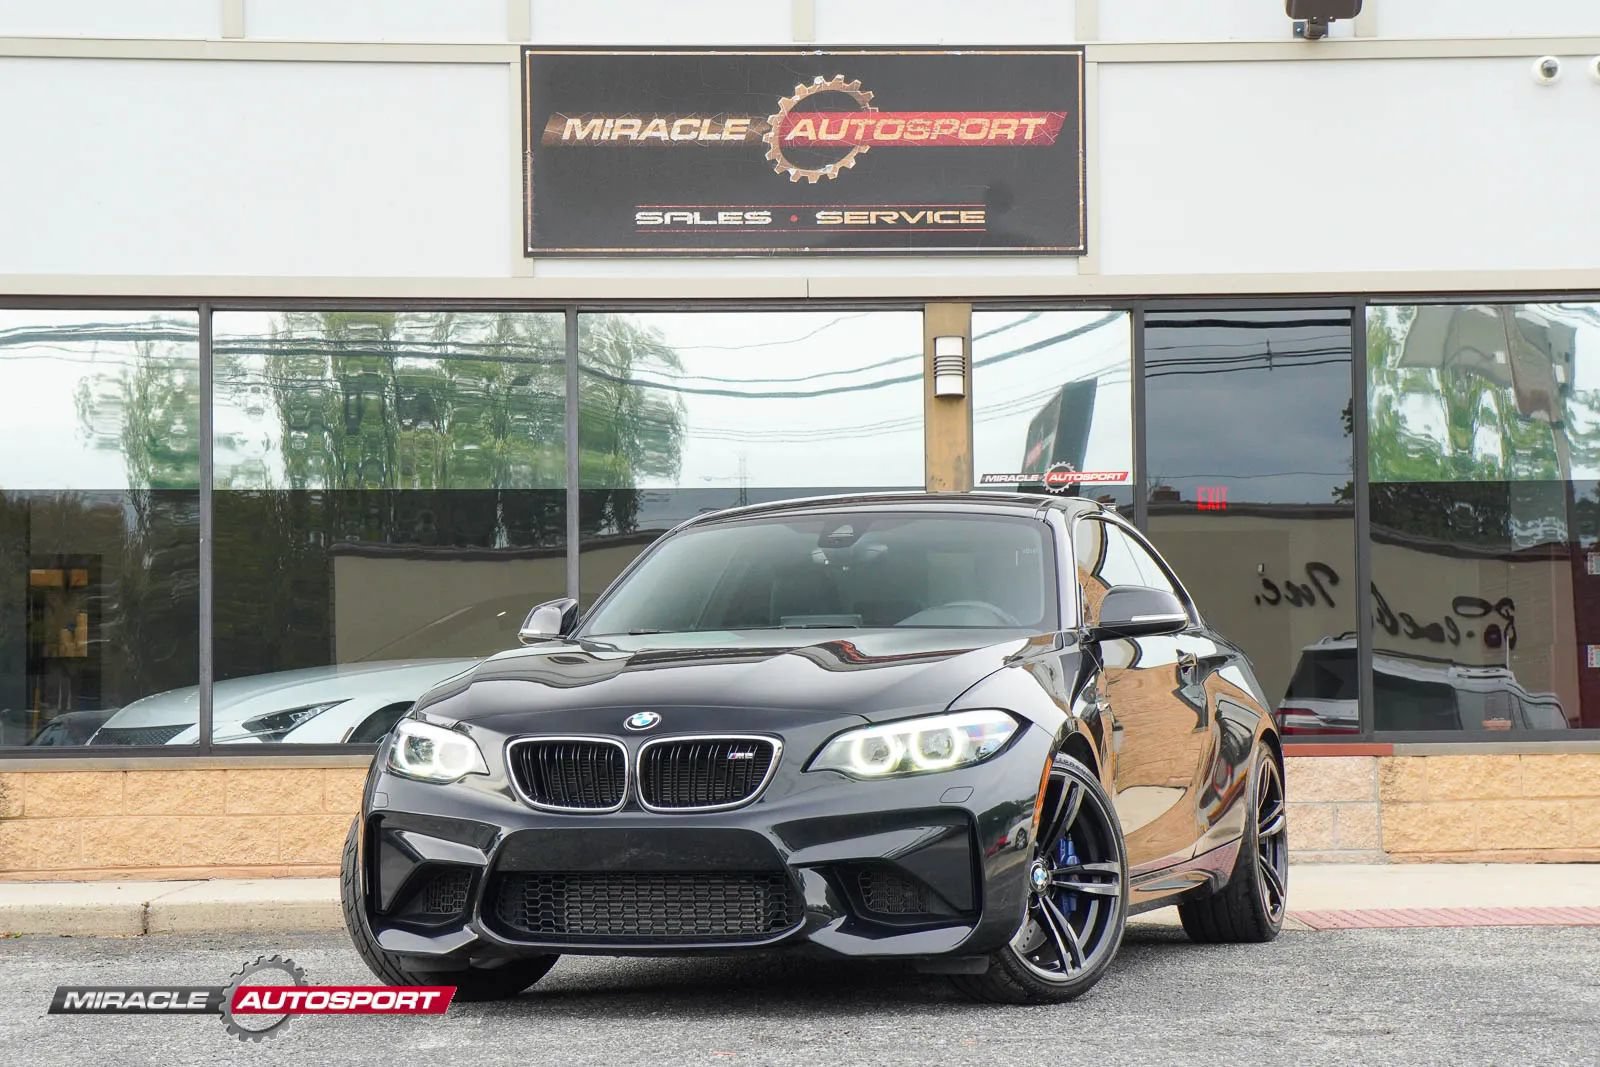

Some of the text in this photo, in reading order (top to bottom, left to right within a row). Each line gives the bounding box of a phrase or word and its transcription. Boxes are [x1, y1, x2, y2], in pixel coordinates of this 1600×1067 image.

[562, 118, 1046, 141] MIRACLE AUTOSPORT
[635, 210, 985, 225] SALES SERVICE
[984, 472, 1124, 482] MIRACLE AUTOSPORT
[1197, 485, 1227, 511] EXIT
